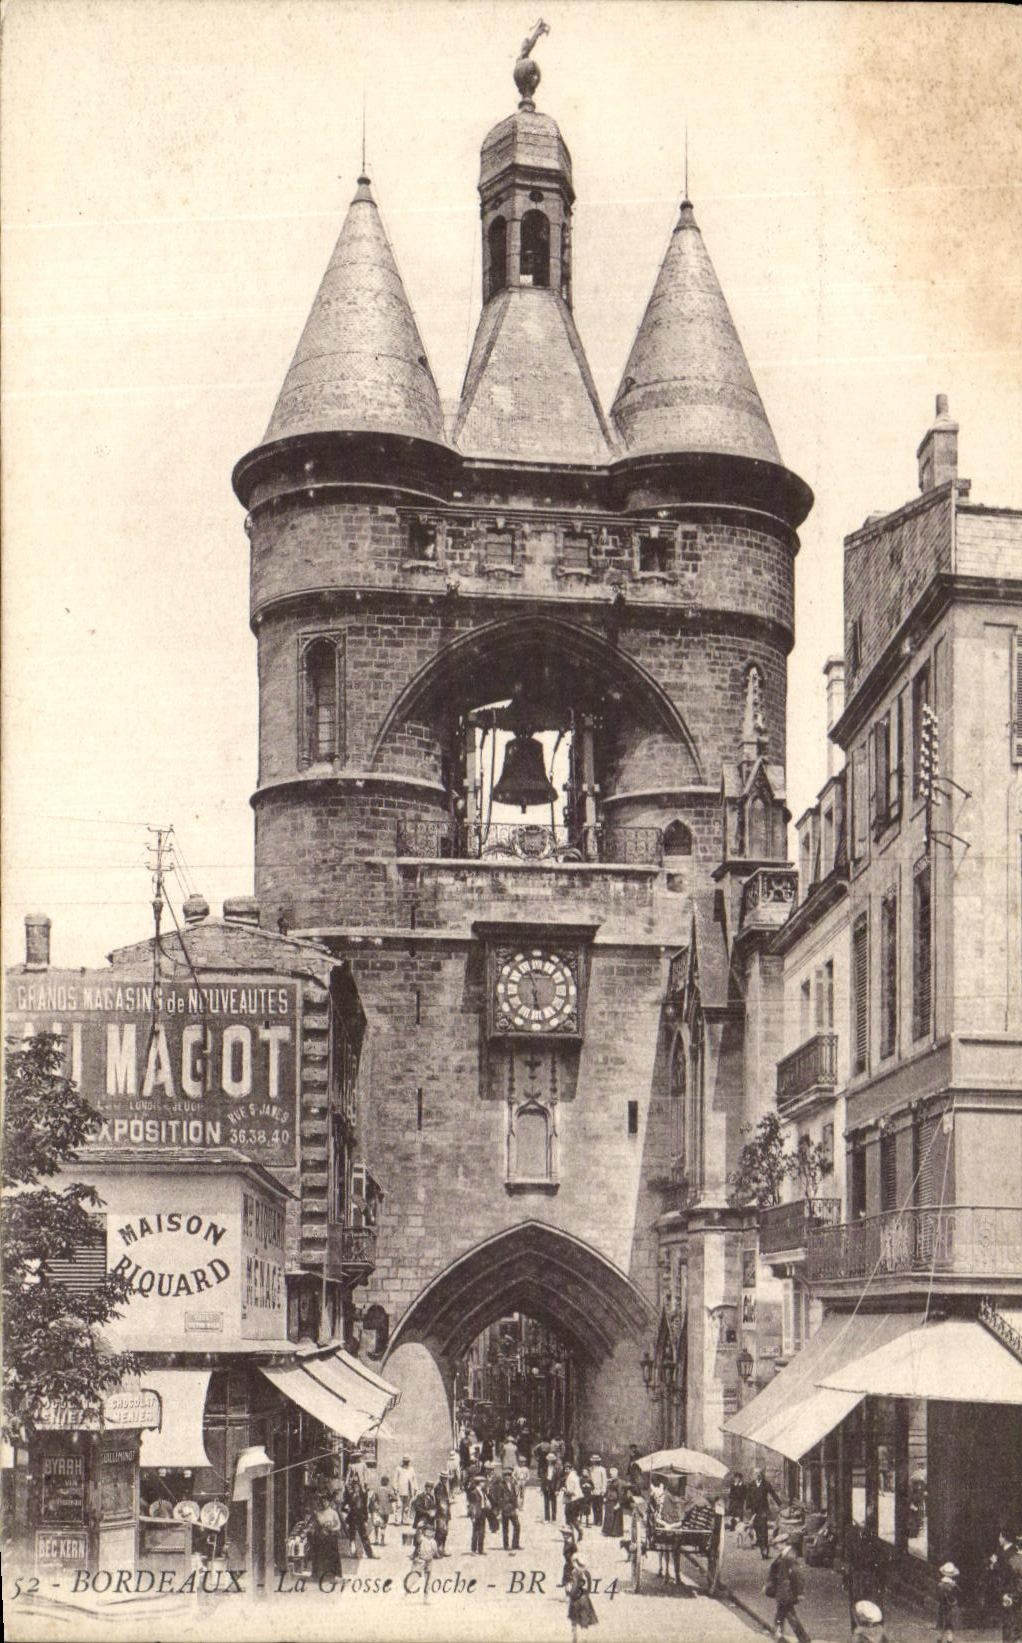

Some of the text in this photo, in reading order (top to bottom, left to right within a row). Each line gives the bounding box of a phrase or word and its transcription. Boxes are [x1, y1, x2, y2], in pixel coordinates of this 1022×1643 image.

[18, 985, 77, 1011] GRANDS
[167, 991, 185, 1013] de
[105, 1023, 290, 1098] MAGOT
[117, 1212, 227, 1246] MAISON
[110, 1253, 231, 1298] RIQUARD
